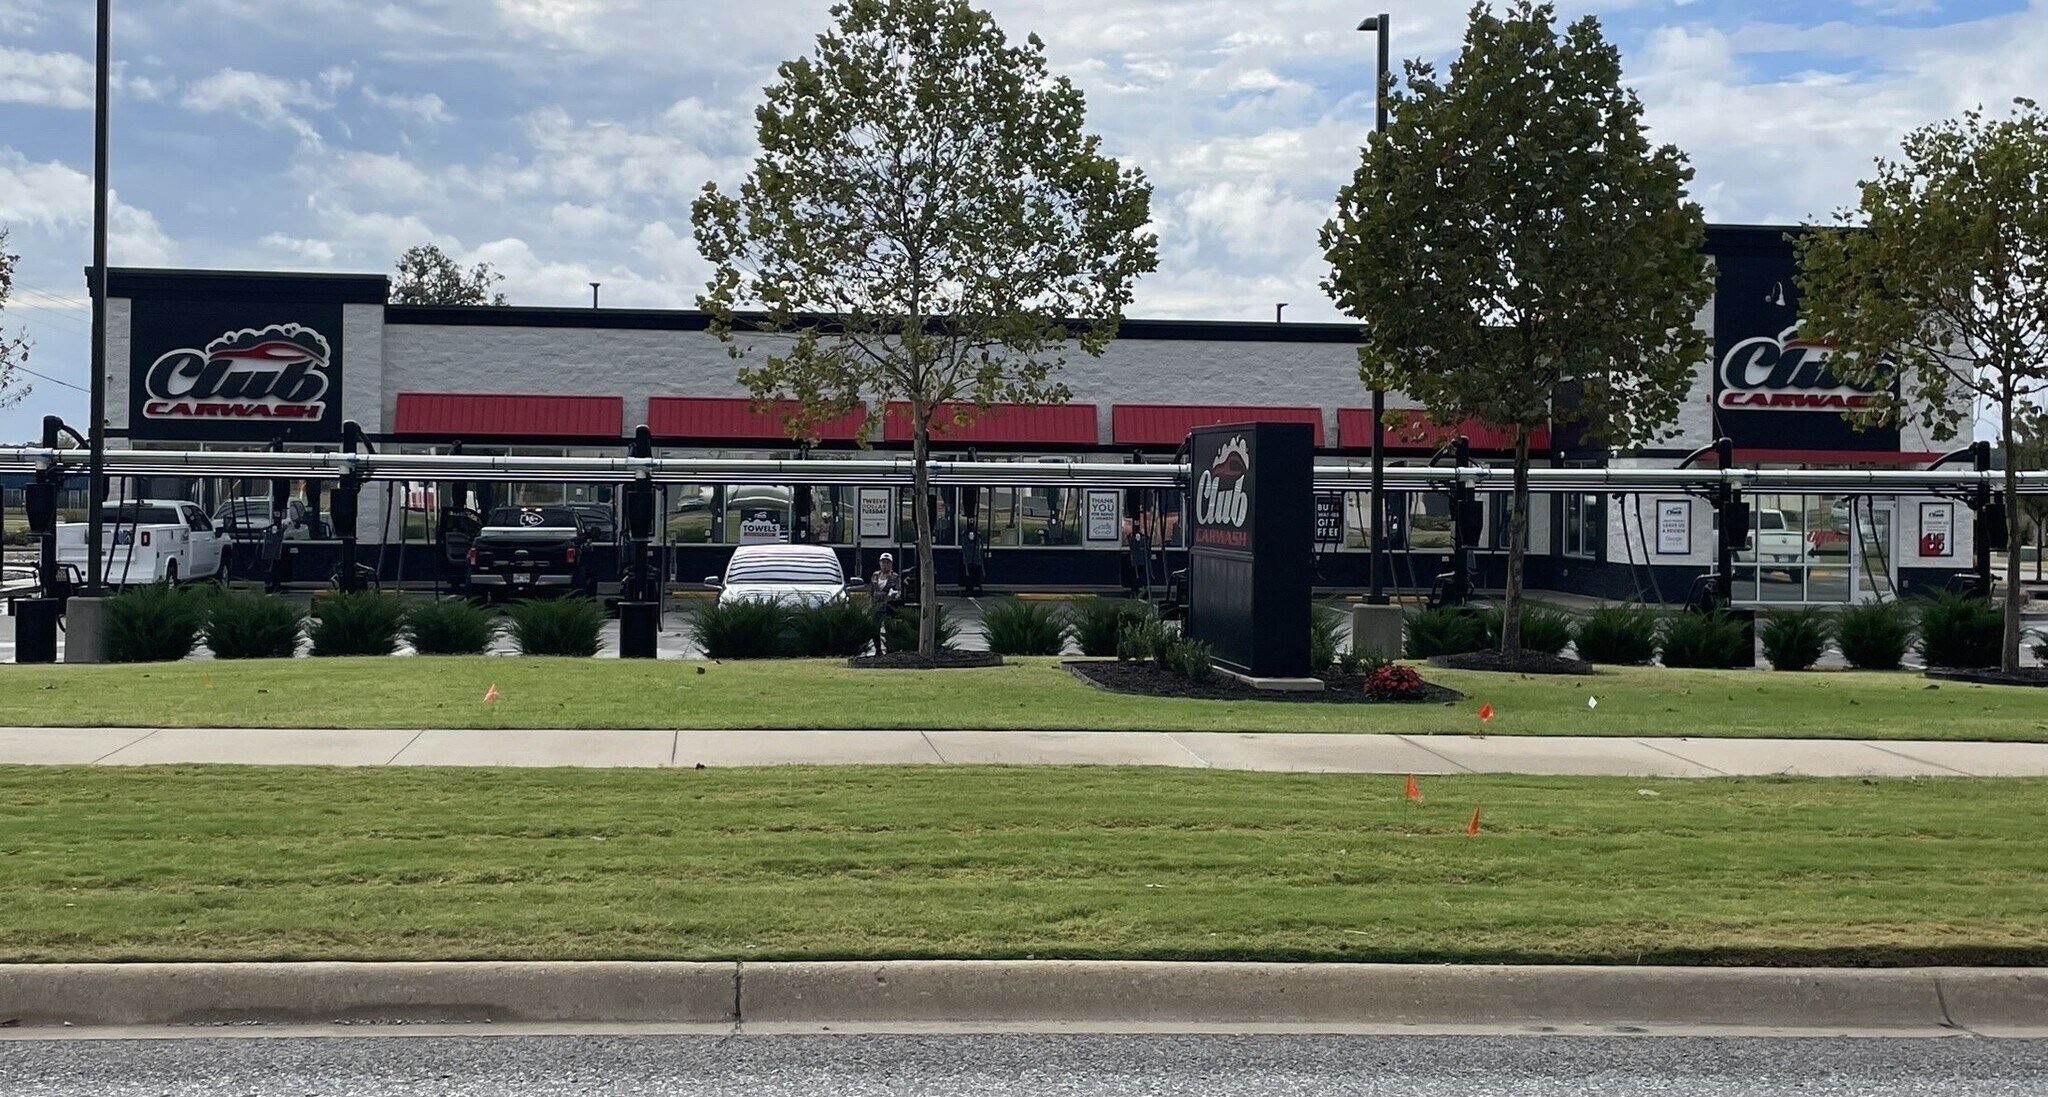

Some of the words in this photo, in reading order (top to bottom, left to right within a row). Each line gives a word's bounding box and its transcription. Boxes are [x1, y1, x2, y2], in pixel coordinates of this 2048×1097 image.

[149, 353, 323, 402] Club
[1723, 393, 1876, 407] CARWAS
[146, 402, 320, 418] CARWASH
[1196, 470, 1248, 528] Club
[1091, 504, 1115, 512] YOU
[1196, 528, 1247, 546] CARWASH
